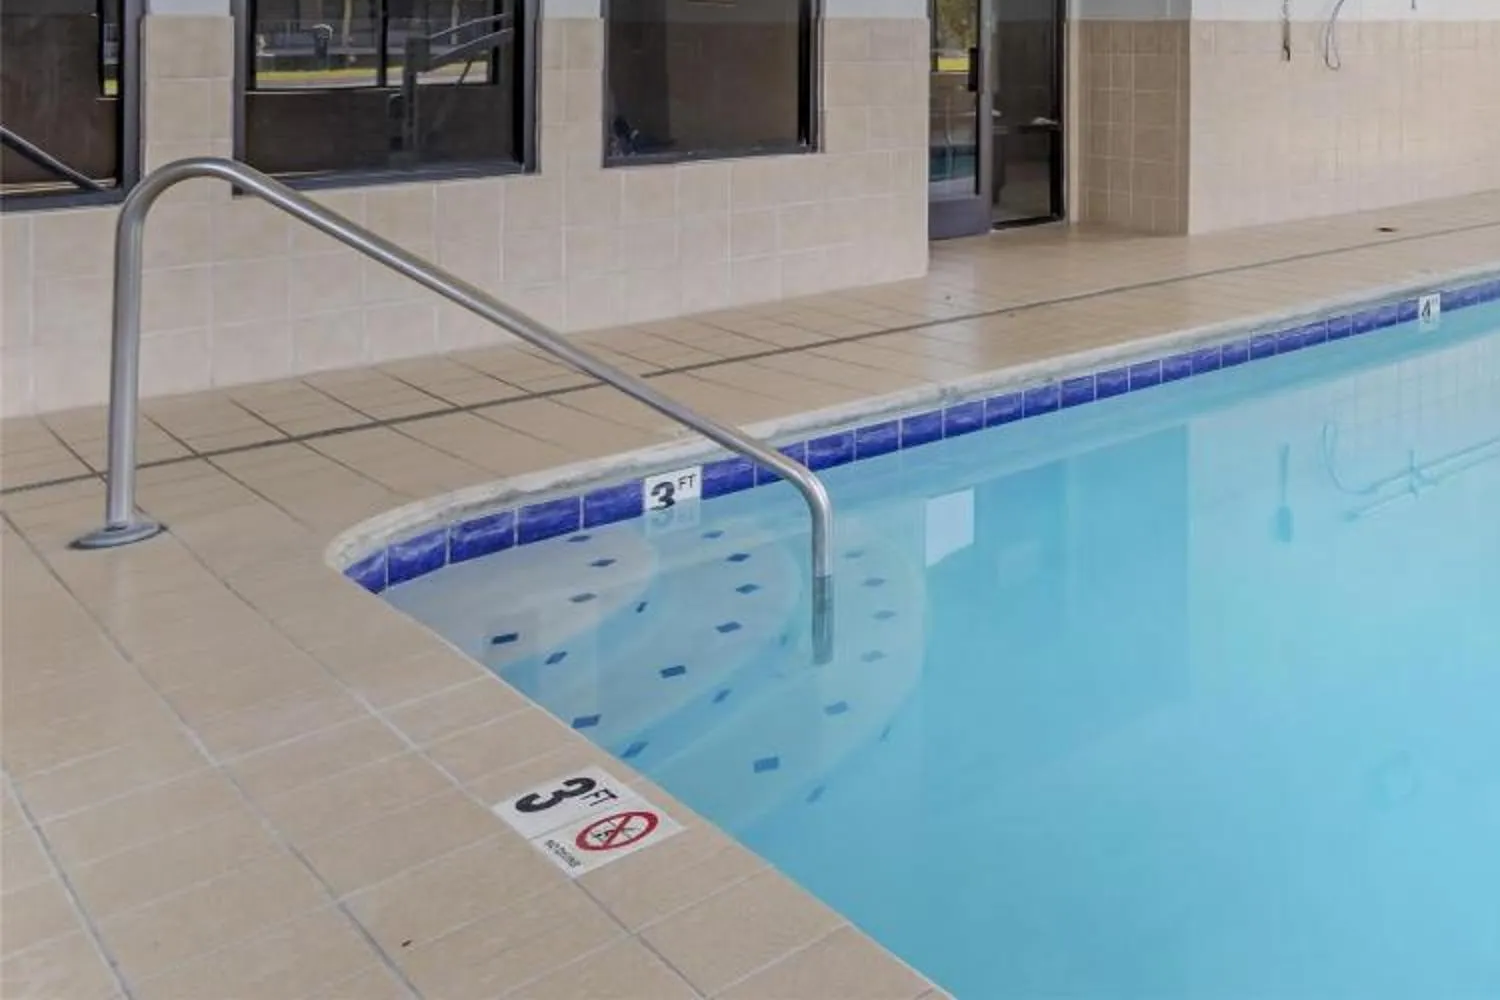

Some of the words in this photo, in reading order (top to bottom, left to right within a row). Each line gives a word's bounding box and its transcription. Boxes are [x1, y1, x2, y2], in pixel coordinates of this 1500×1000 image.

[650, 481, 676, 511] 3
[677, 473, 698, 491] FT
[515, 777, 596, 813] 3
[580, 788, 619, 807] FT
